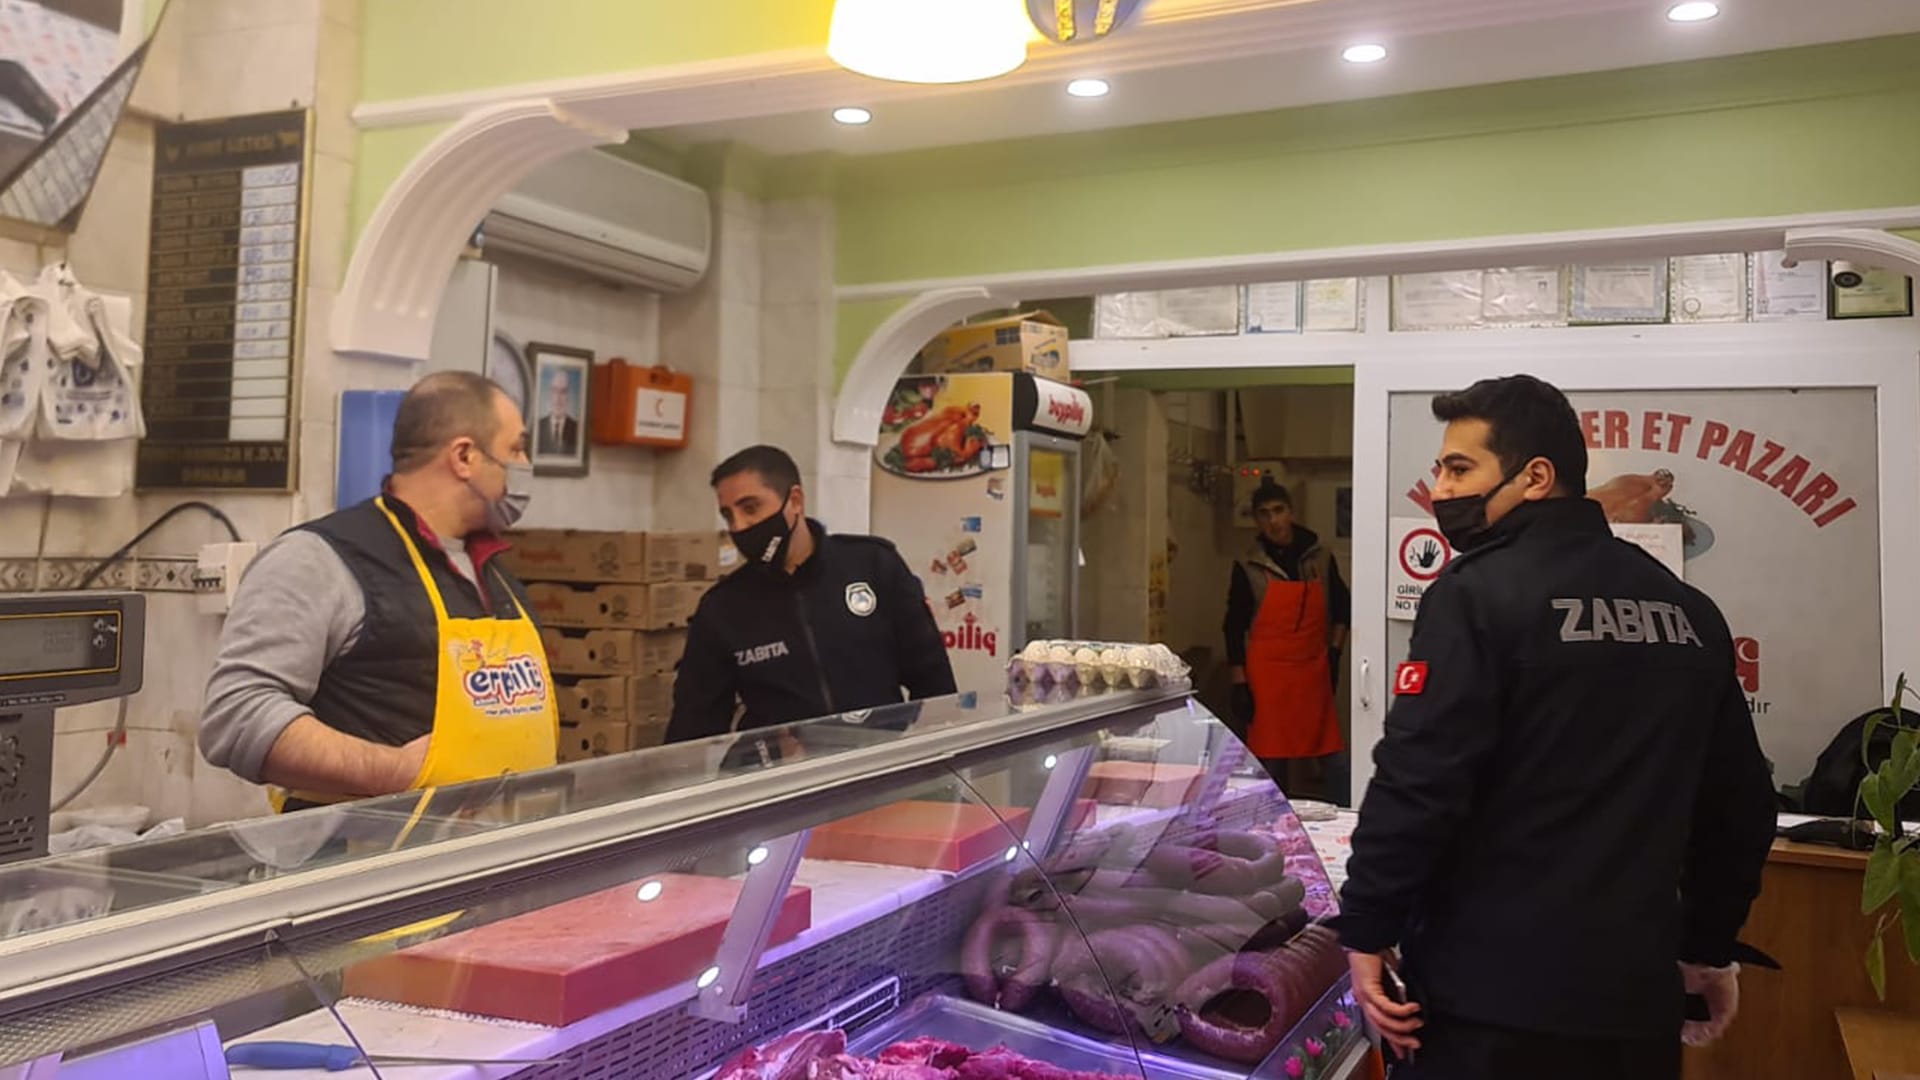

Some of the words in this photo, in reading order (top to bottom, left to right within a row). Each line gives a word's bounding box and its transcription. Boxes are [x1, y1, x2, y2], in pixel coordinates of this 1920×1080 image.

[1642, 411, 1692, 454] ET
[1696, 420, 1857, 528] PAZARI
[1395, 600, 1411, 610] NO
[1551, 598, 1704, 648] ZABITA
[734, 641, 790, 666] ZABITA
